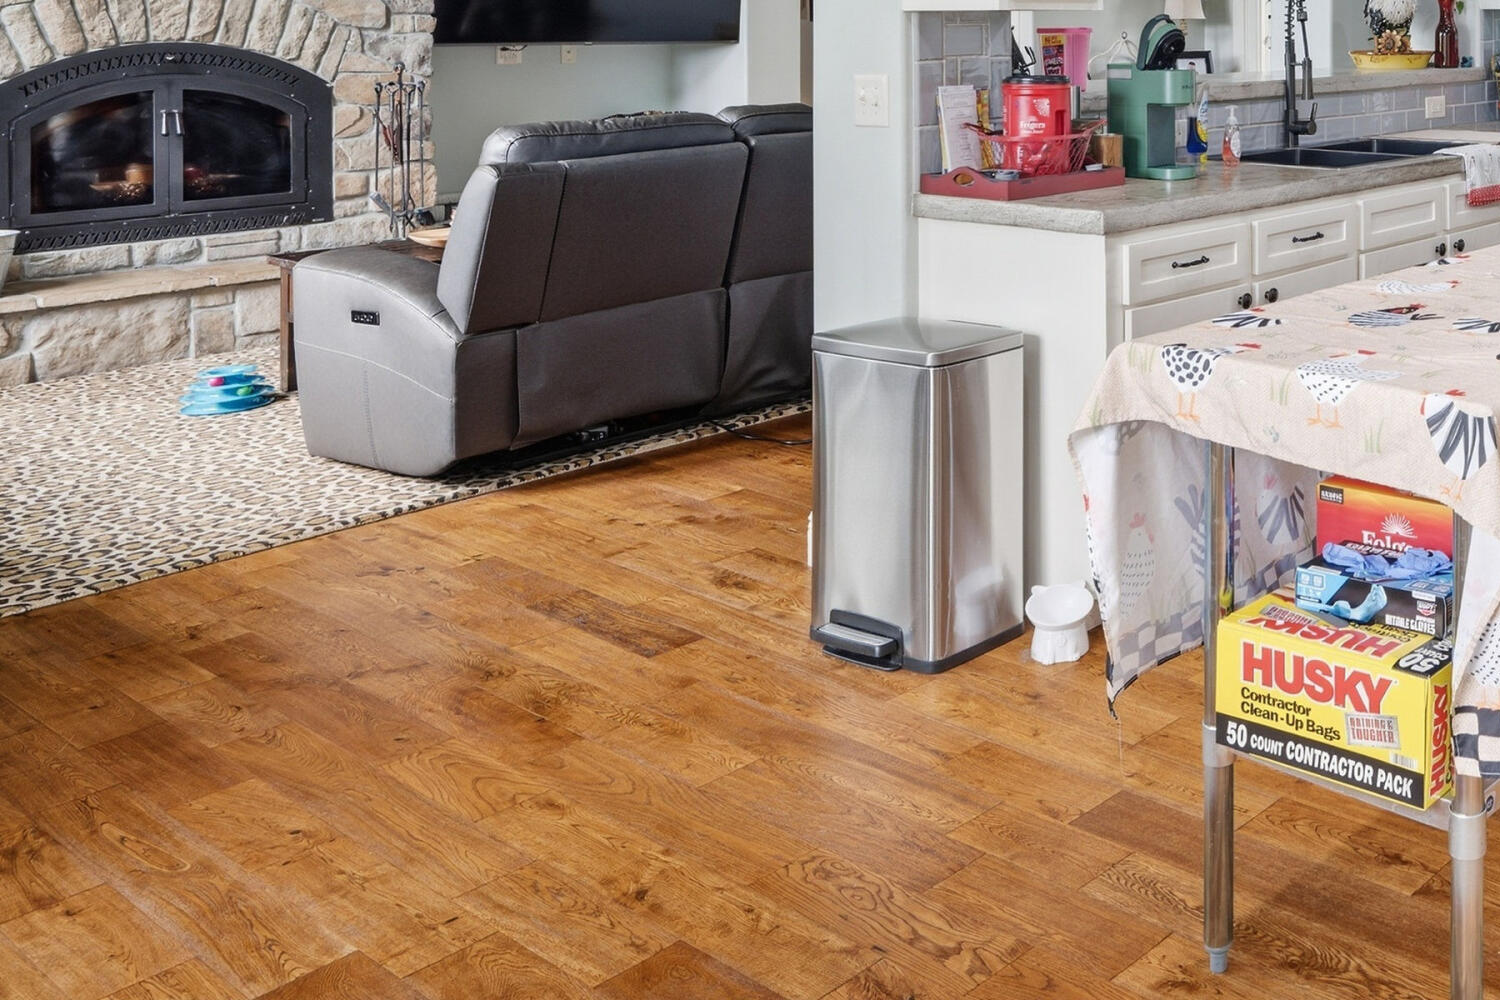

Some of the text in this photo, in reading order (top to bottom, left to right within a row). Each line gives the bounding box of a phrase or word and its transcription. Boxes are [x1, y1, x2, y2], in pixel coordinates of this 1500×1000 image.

[1245, 616, 1400, 658] HUSKY
[1385, 613, 1410, 632] NITRILE
[1409, 617, 1436, 635] GLOVES
[1243, 641, 1393, 715] HUSKY
[1399, 652, 1441, 673] 50
[1241, 686, 1312, 718] Contractor
[1305, 720, 1341, 741] Bags
[1351, 728, 1396, 744] TOUGHER
[1430, 684, 1448, 797] HUSKY
[1226, 720, 1414, 799] 50 COUNT CONTRACTOR PACK
